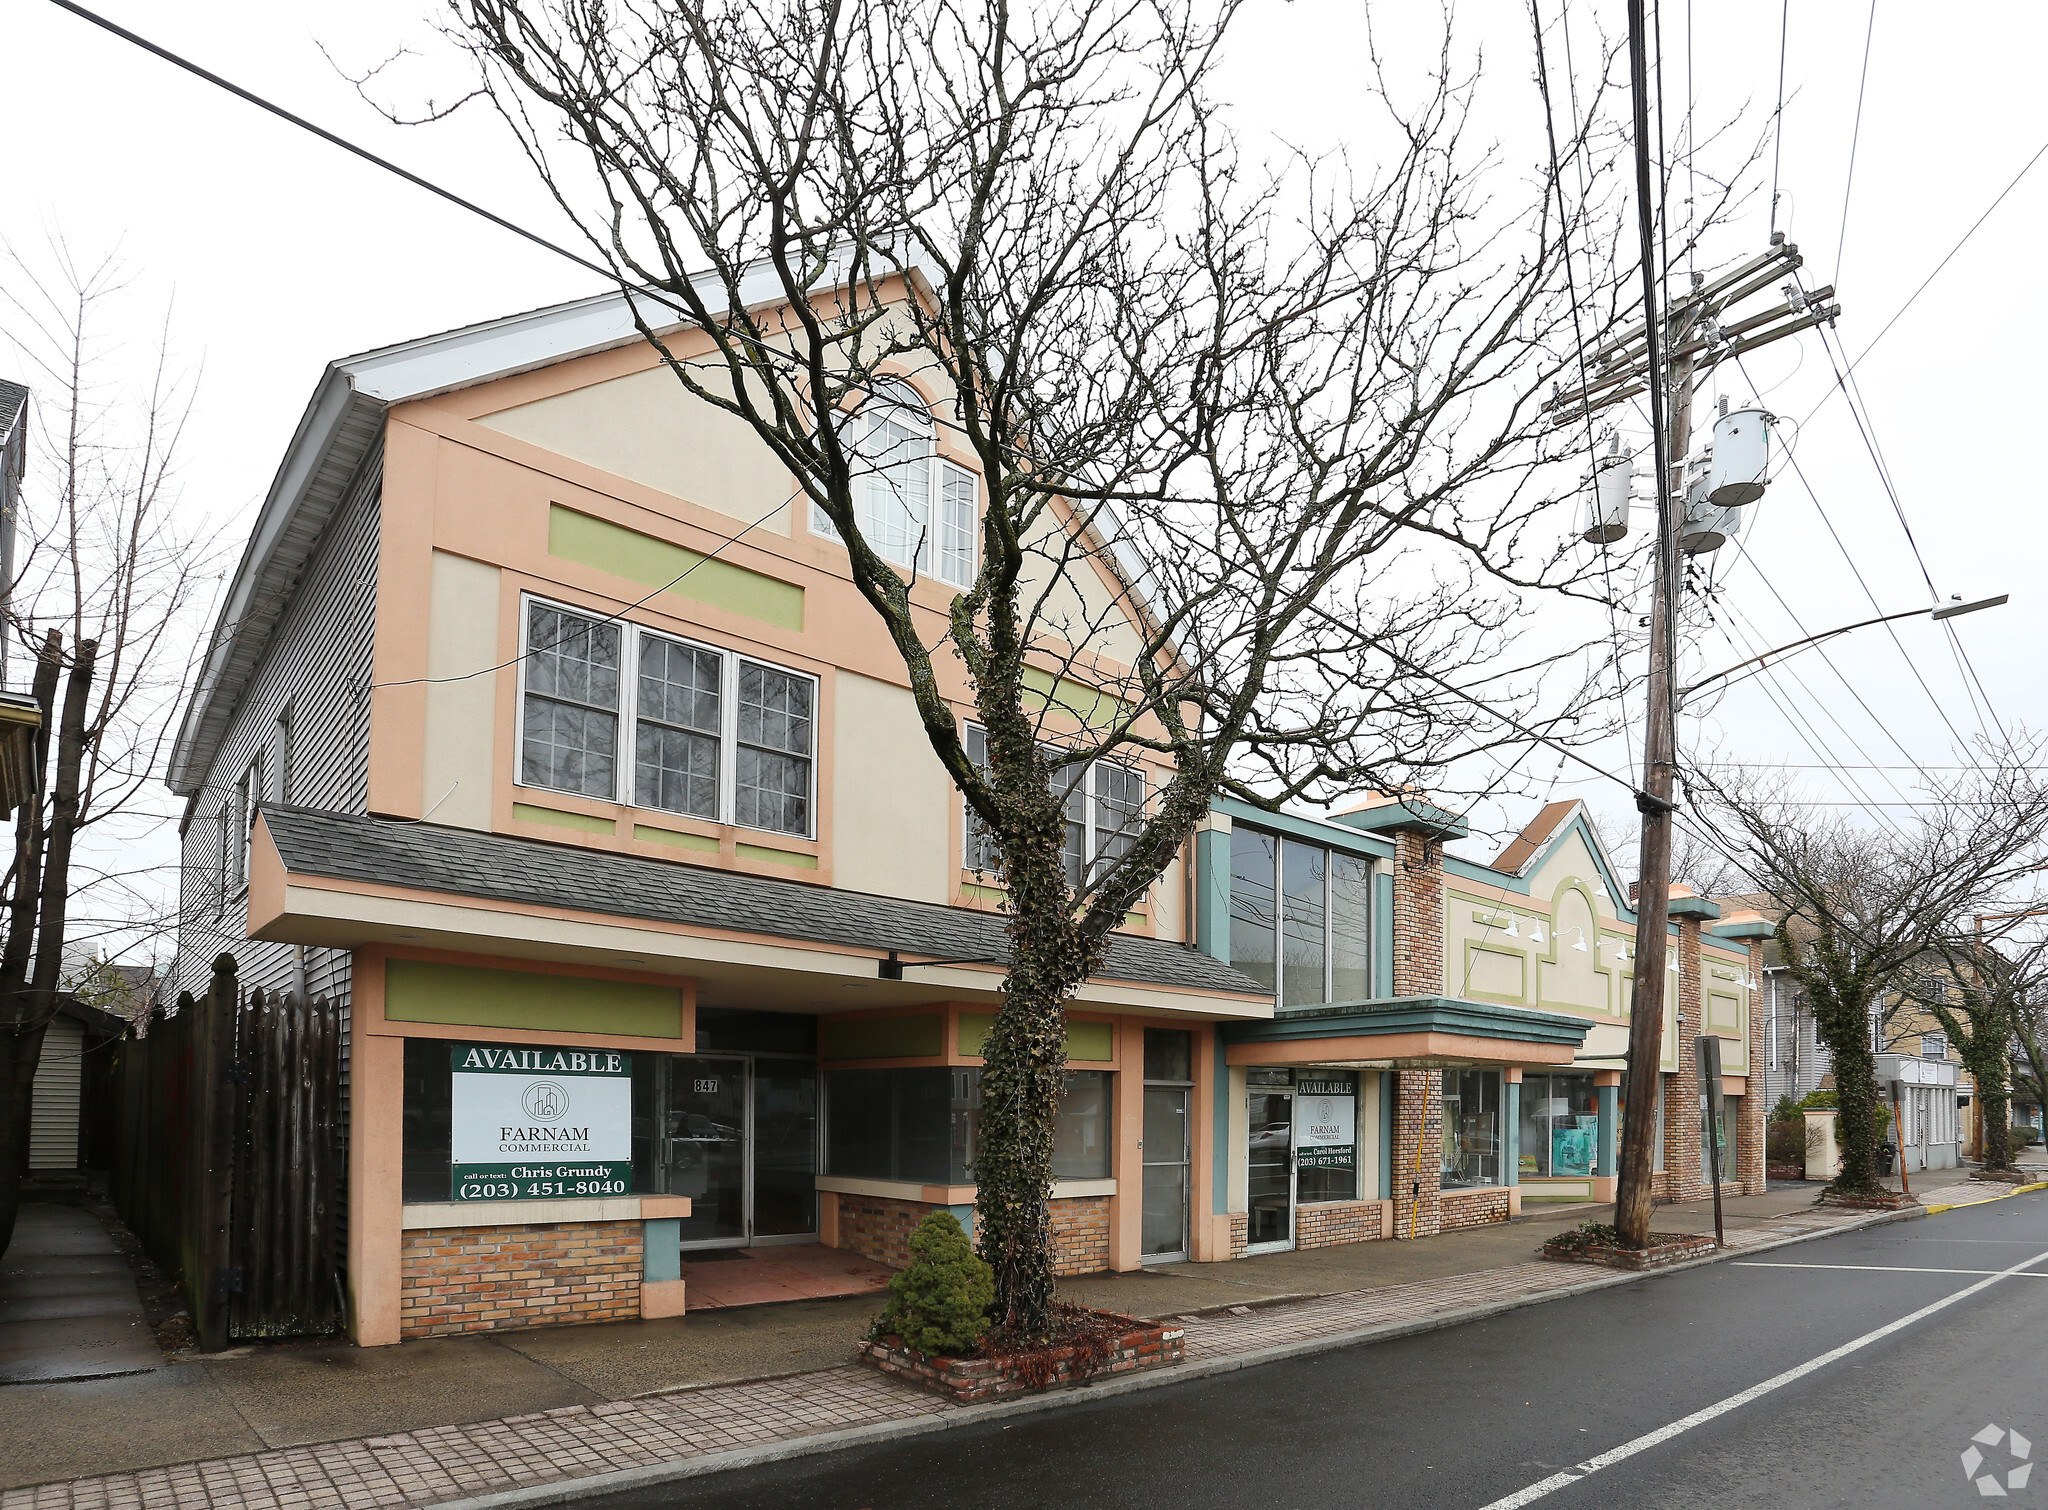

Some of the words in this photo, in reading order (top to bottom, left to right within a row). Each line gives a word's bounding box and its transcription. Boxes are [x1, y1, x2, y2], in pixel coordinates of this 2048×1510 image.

[462, 1047, 622, 1072] AVAILABLE
[695, 1080, 717, 1092] 847
[1299, 1082, 1352, 1094] AVAILABLE
[500, 1127, 590, 1141] FARNAM
[1310, 1125, 1340, 1134] FARNAM
[499, 1143, 591, 1153] COMMERCIAL
[1297, 1157, 1316, 1167] (203)
[1318, 1156, 1352, 1165] 671-1961
[511, 1166, 553, 1179] Chris
[556, 1165, 612, 1179] Grundy
[460, 1183, 519, 1200] (203)
[527, 1180, 625, 1196] 451-8040
